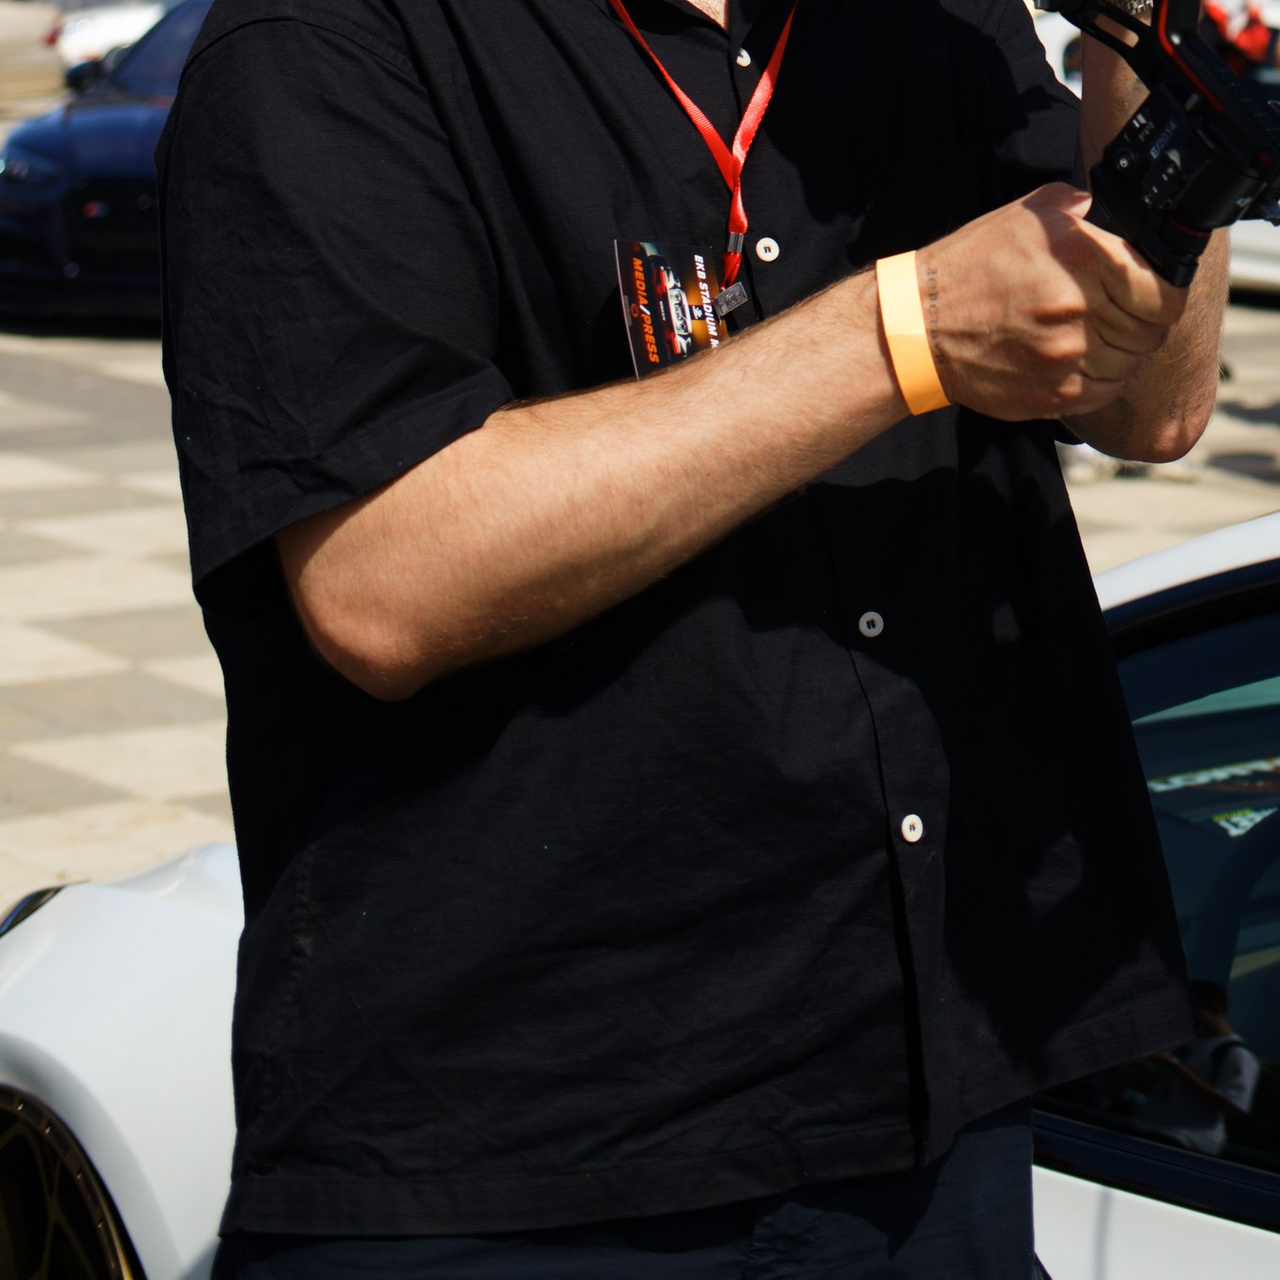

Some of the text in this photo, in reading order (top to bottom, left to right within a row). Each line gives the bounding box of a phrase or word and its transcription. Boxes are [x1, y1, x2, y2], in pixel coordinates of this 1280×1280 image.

[694, 254, 707, 280] EKB
[633, 257, 659, 363] MEDIA/PRESS
[699, 281, 718, 337] STADIUM
